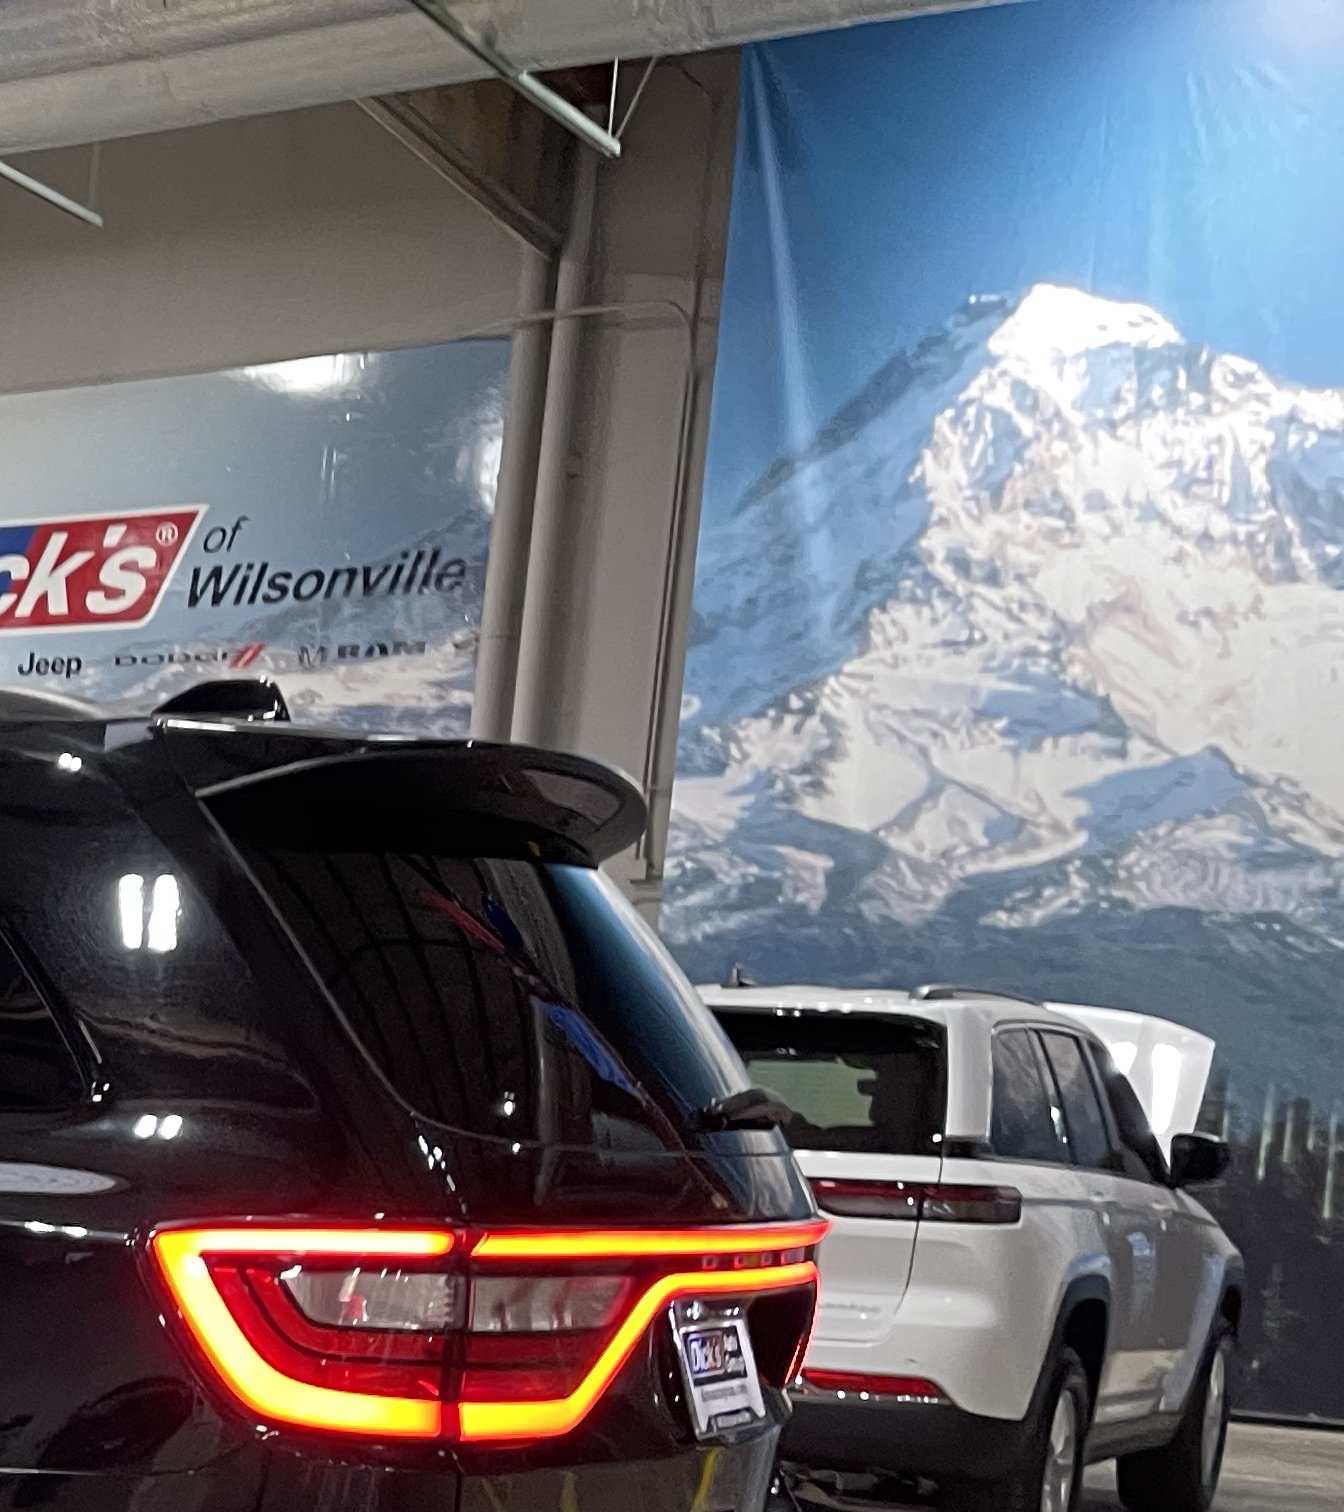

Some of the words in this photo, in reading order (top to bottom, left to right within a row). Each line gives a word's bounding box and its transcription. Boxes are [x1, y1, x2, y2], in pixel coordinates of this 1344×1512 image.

[203, 515, 250, 554] of
[187, 546, 468, 609] Wilsonville
[17, 651, 82, 679] Jeep
